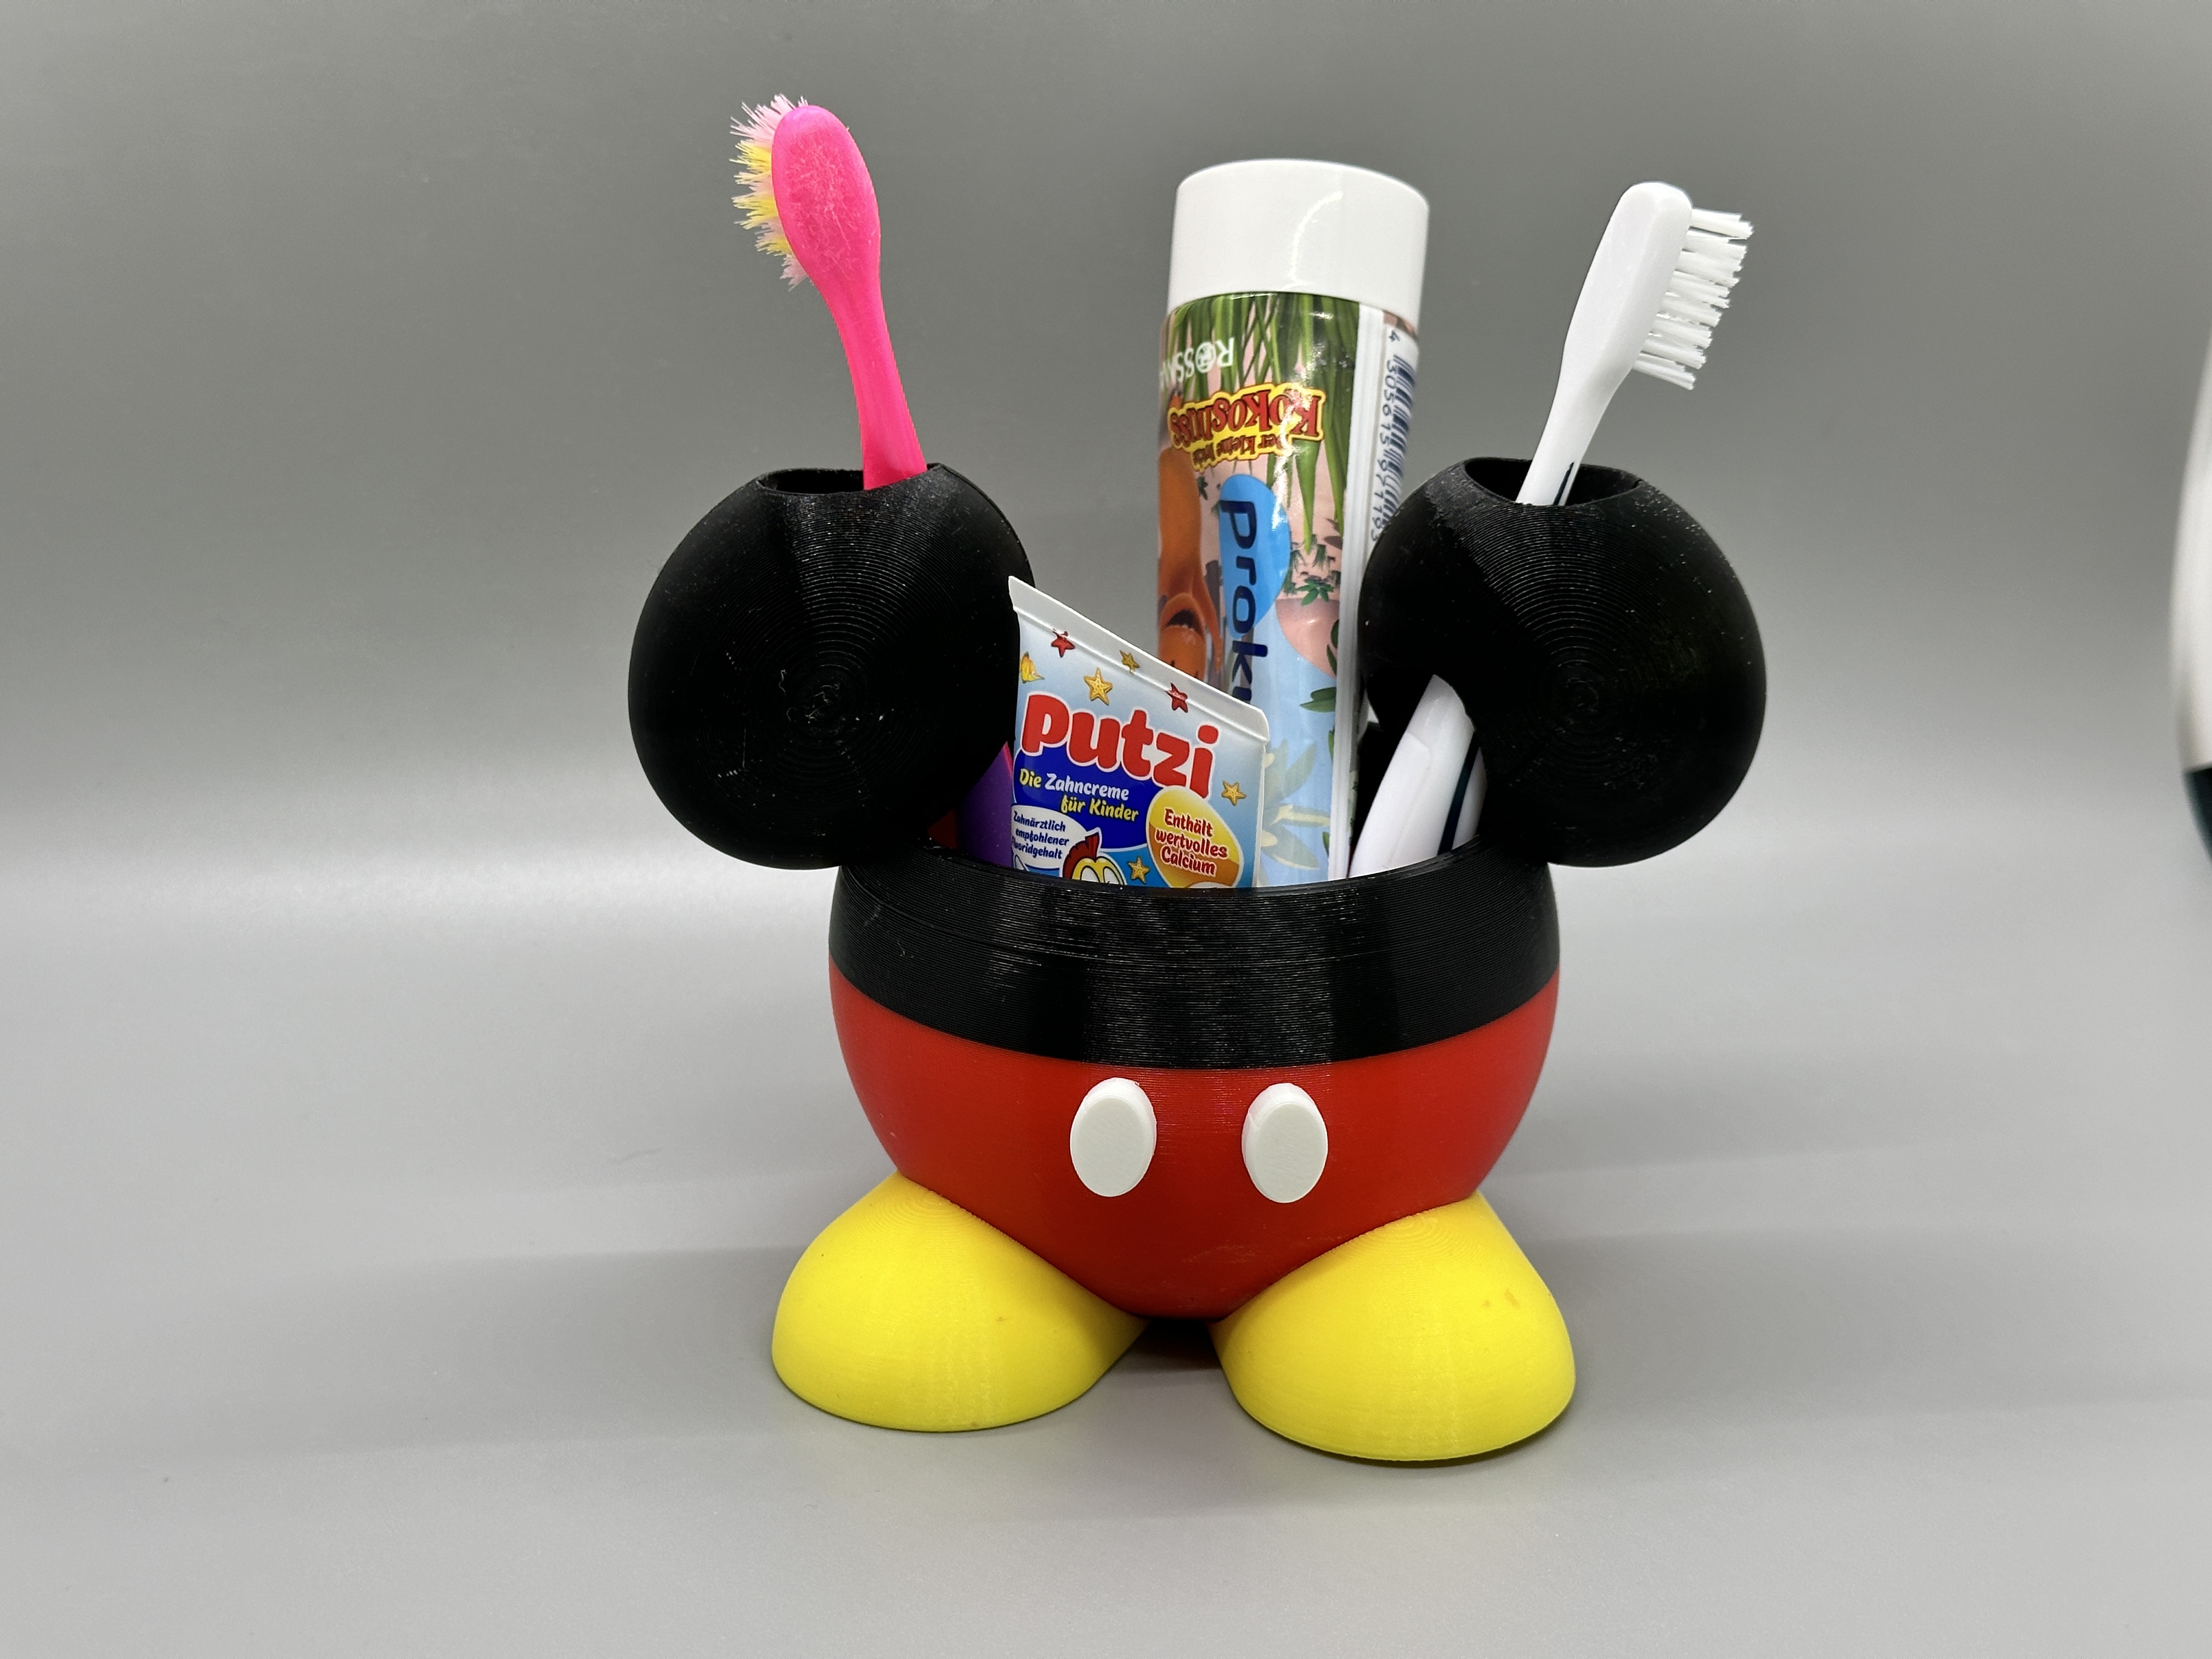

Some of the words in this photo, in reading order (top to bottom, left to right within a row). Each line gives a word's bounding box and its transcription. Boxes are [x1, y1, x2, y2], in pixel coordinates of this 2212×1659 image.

[1389, 330, 1401, 343] 4
[1380, 359, 1397, 445] 305615
[1022, 694, 1219, 799] putzi
[1019, 768, 1042, 788] Die
[1045, 772, 1130, 801] Zahncreme
[1013, 810, 1066, 833] Zahnärztlich
[1060, 794, 1086, 814] für
[1089, 797, 1139, 822] Kinder
[1164, 808, 1214, 838] Enthält
[1015, 828, 1070, 847] empfohlener
[1155, 828, 1228, 858] wertvolles
[1161, 845, 1216, 875] Calcium
